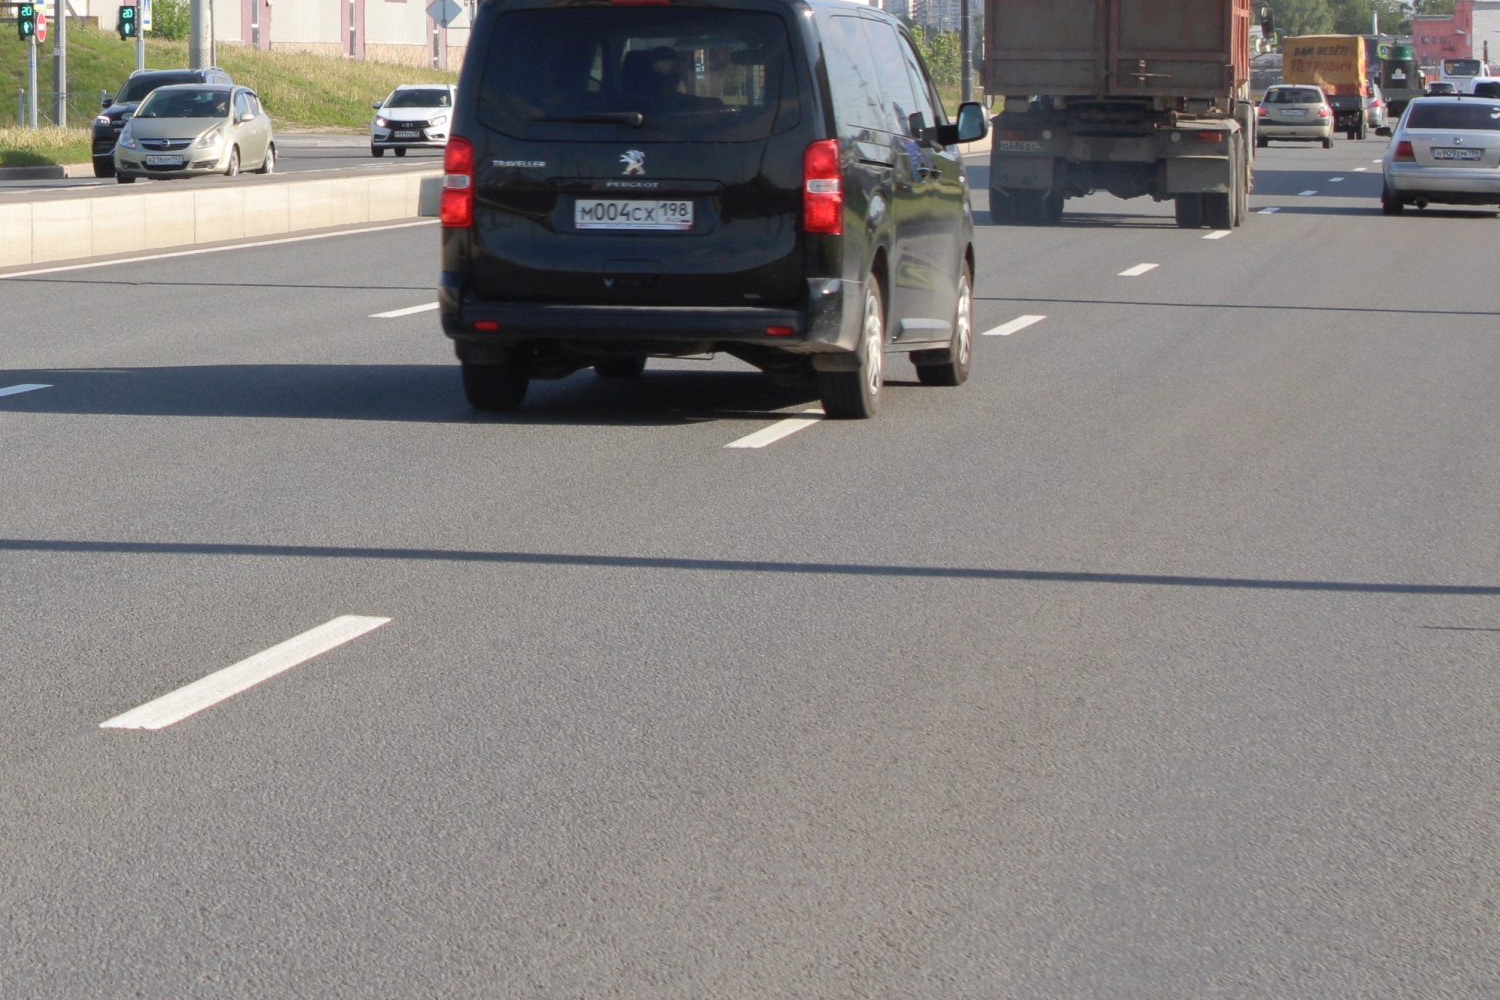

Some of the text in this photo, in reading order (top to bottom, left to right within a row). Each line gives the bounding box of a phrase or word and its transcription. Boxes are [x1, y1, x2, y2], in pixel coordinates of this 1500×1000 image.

[21, 6, 33, 17] 20
[122, 8, 134, 19] 20
[492, 160, 546, 168] TRAVELLER
[606, 181, 659, 189] PEUGEOT
[660, 202, 688, 217] 198
